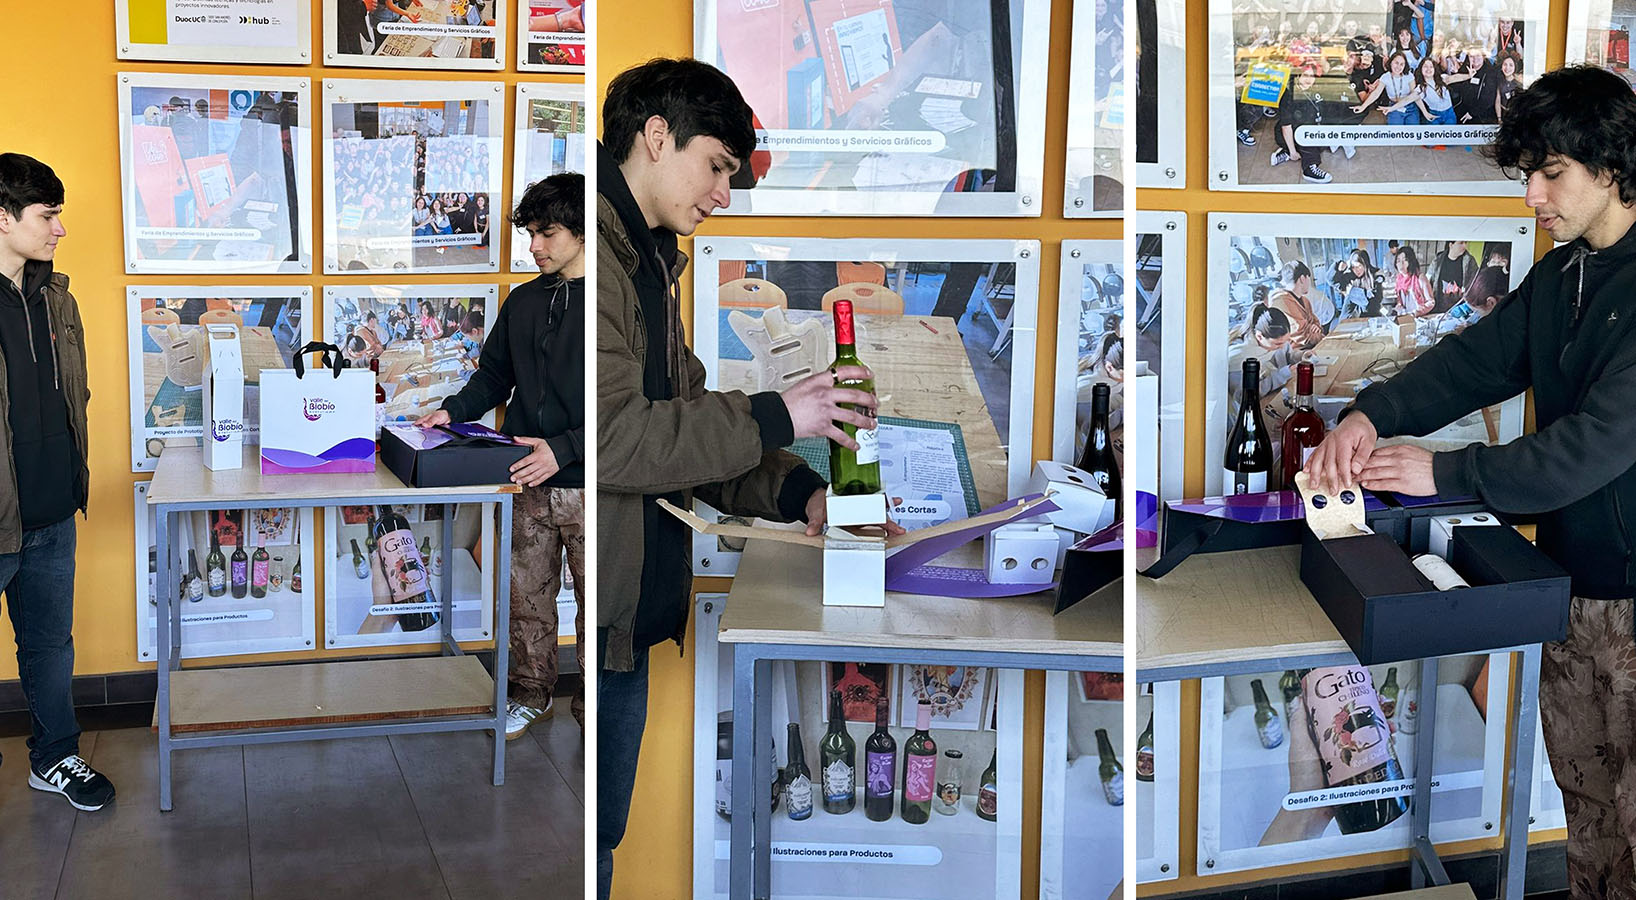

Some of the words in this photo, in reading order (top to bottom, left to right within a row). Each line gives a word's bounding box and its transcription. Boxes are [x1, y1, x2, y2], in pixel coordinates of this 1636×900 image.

[252, 16, 270, 25] hub
[762, 136, 840, 148] Emprendimientos
[842, 138, 848, 147] y
[850, 136, 892, 146] Servicios
[894, 136, 932, 146] Gráficos
[1304, 131, 1326, 140] Feria
[1327, 131, 1339, 140] de
[1340, 130, 1414, 142] Emprendimientos
[1416, 132, 1422, 140] y
[1424, 130, 1462, 139] Servicios
[908, 505, 937, 514] Cortas
[384, 536, 412, 552] Gato
[1314, 669, 1366, 699] Gato
[1288, 795, 1319, 806] Desafío
[1320, 794, 1328, 802] 2:
[1329, 788, 1380, 800] Ilustraciones
[1381, 785, 1399, 795] para
[1400, 780, 1440, 791] Proos
[773, 847, 828, 856] Ilustraciones
[828, 850, 848, 858] para
[850, 849, 893, 858] Productos
